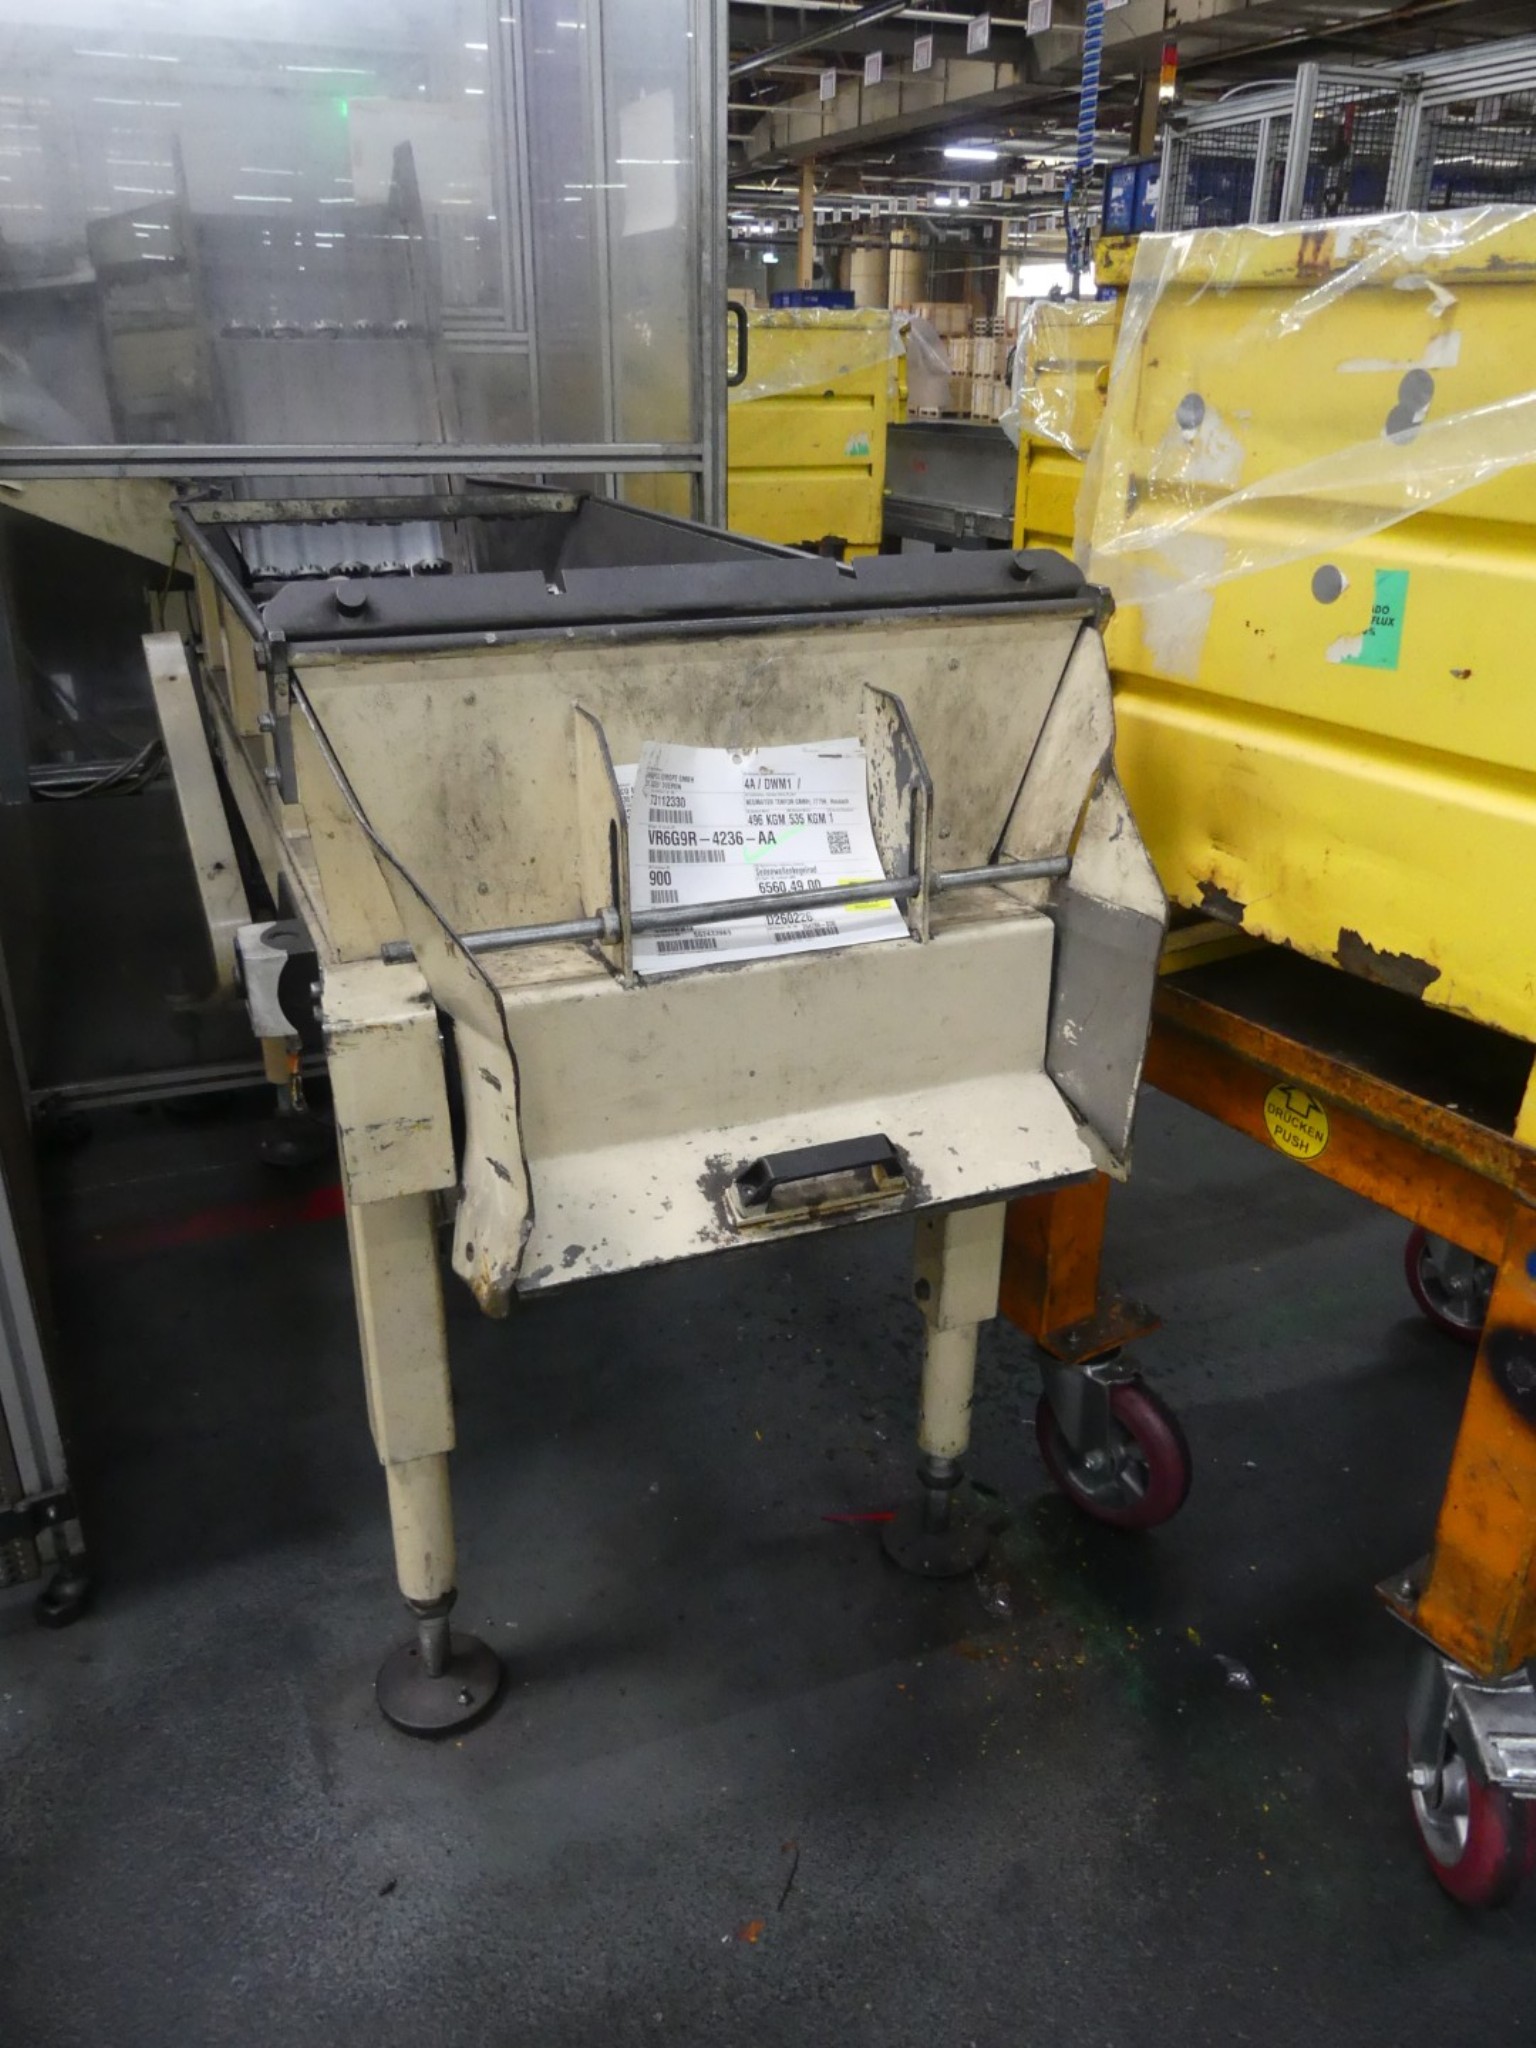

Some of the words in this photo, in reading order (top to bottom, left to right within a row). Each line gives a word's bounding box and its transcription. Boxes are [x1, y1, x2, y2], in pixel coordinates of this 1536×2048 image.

[744, 777, 756, 790] 4A
[764, 777, 792, 790] DWM1
[747, 814, 763, 826] 496
[765, 814, 786, 826] KGM
[789, 813, 805, 825] 535
[807, 813, 827, 825] KGM
[649, 870, 672, 886] 900
[1274, 1124, 1309, 1154] PUSH
